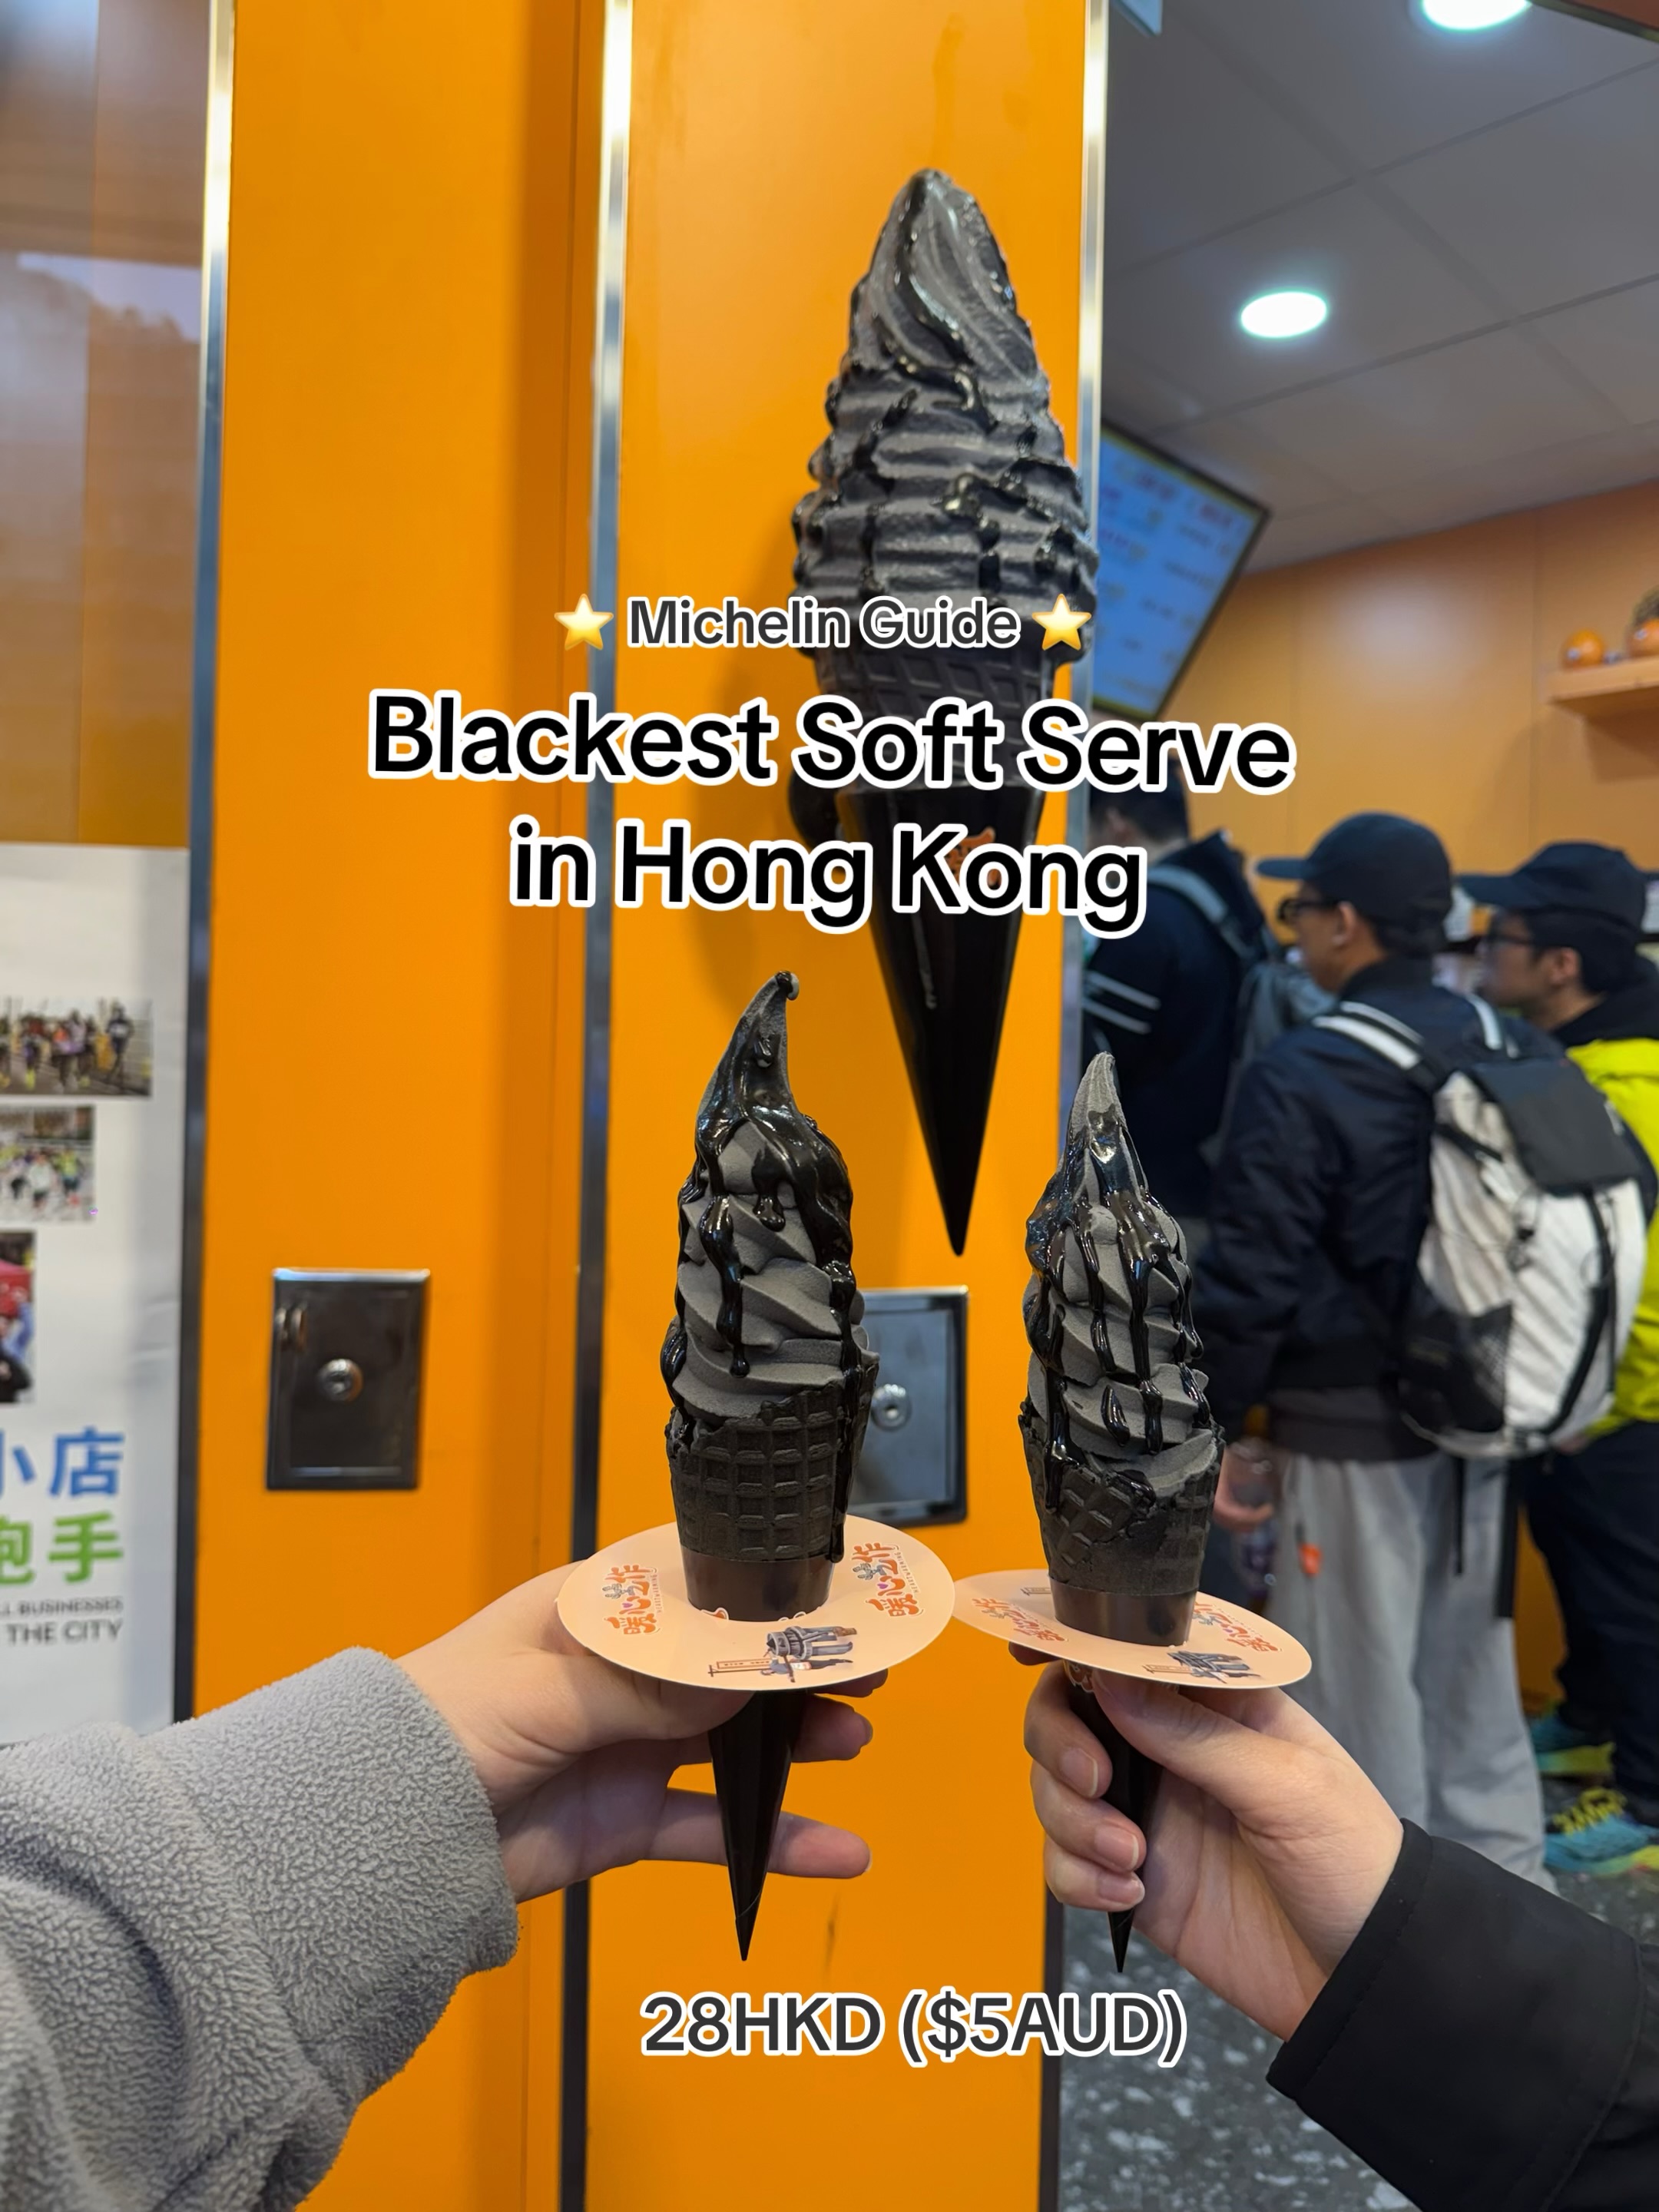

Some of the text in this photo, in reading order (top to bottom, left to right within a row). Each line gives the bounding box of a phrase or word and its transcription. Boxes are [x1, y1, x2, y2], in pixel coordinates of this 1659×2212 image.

[894, 1551, 919, 1594] HEARTWARMING
[19, 1596, 124, 1616] BUSINESSES
[7, 1617, 123, 1645] THE CITY
